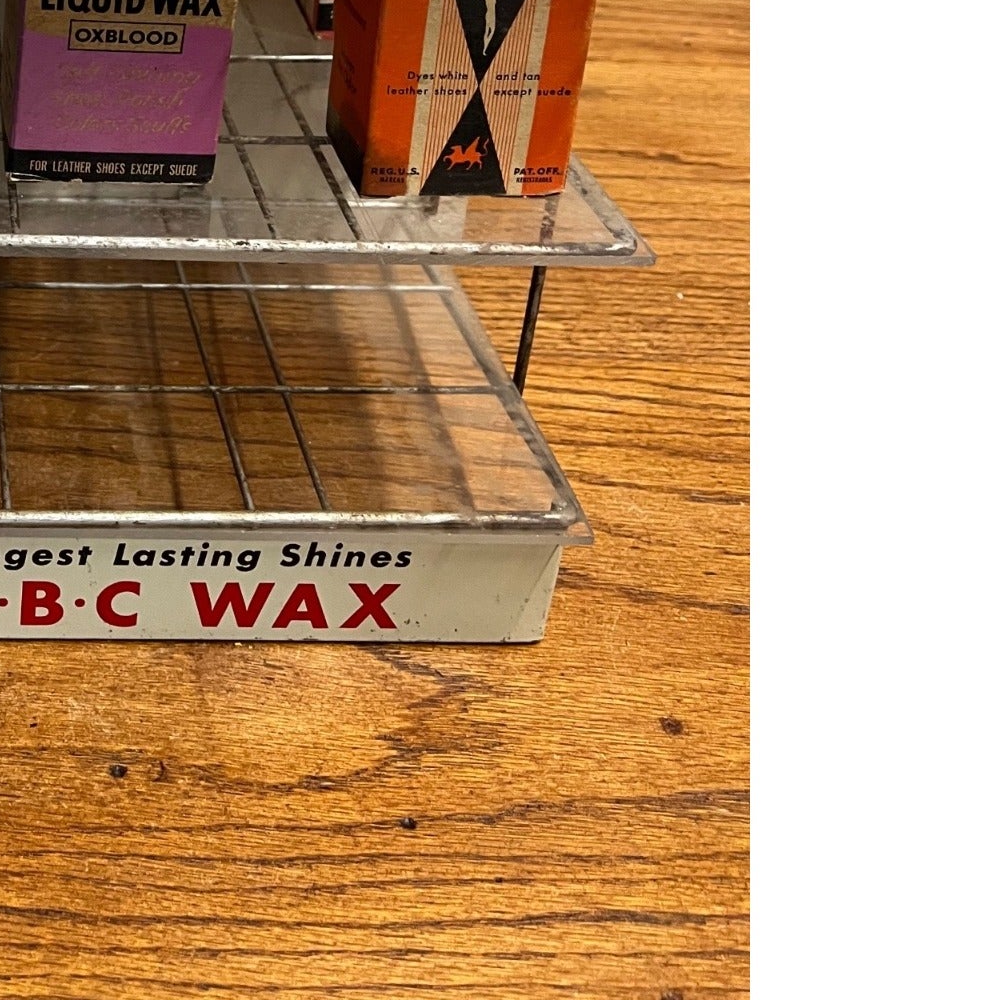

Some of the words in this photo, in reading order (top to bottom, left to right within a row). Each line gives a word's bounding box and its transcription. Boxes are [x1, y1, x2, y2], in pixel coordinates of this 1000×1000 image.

[75, 28, 178, 46] OXBLOOD
[407, 71, 434, 82] Dyes
[438, 71, 468, 81] white
[496, 72, 518, 81] and
[522, 72, 540, 81] tan
[387, 86, 428, 96] leather
[434, 87, 467, 96] shoes
[494, 88, 532, 98] except
[537, 87, 571, 96] suede
[29, 159, 48, 171] FOR
[52, 160, 91, 173] LEATHER
[96, 162, 126, 174] SHOES
[130, 163, 164, 175] EXCEPT
[169, 164, 198, 176] SUEDE
[113, 543, 259, 571] Lasting
[280, 543, 412, 569] Shines
[190, 582, 402, 629] WAX
